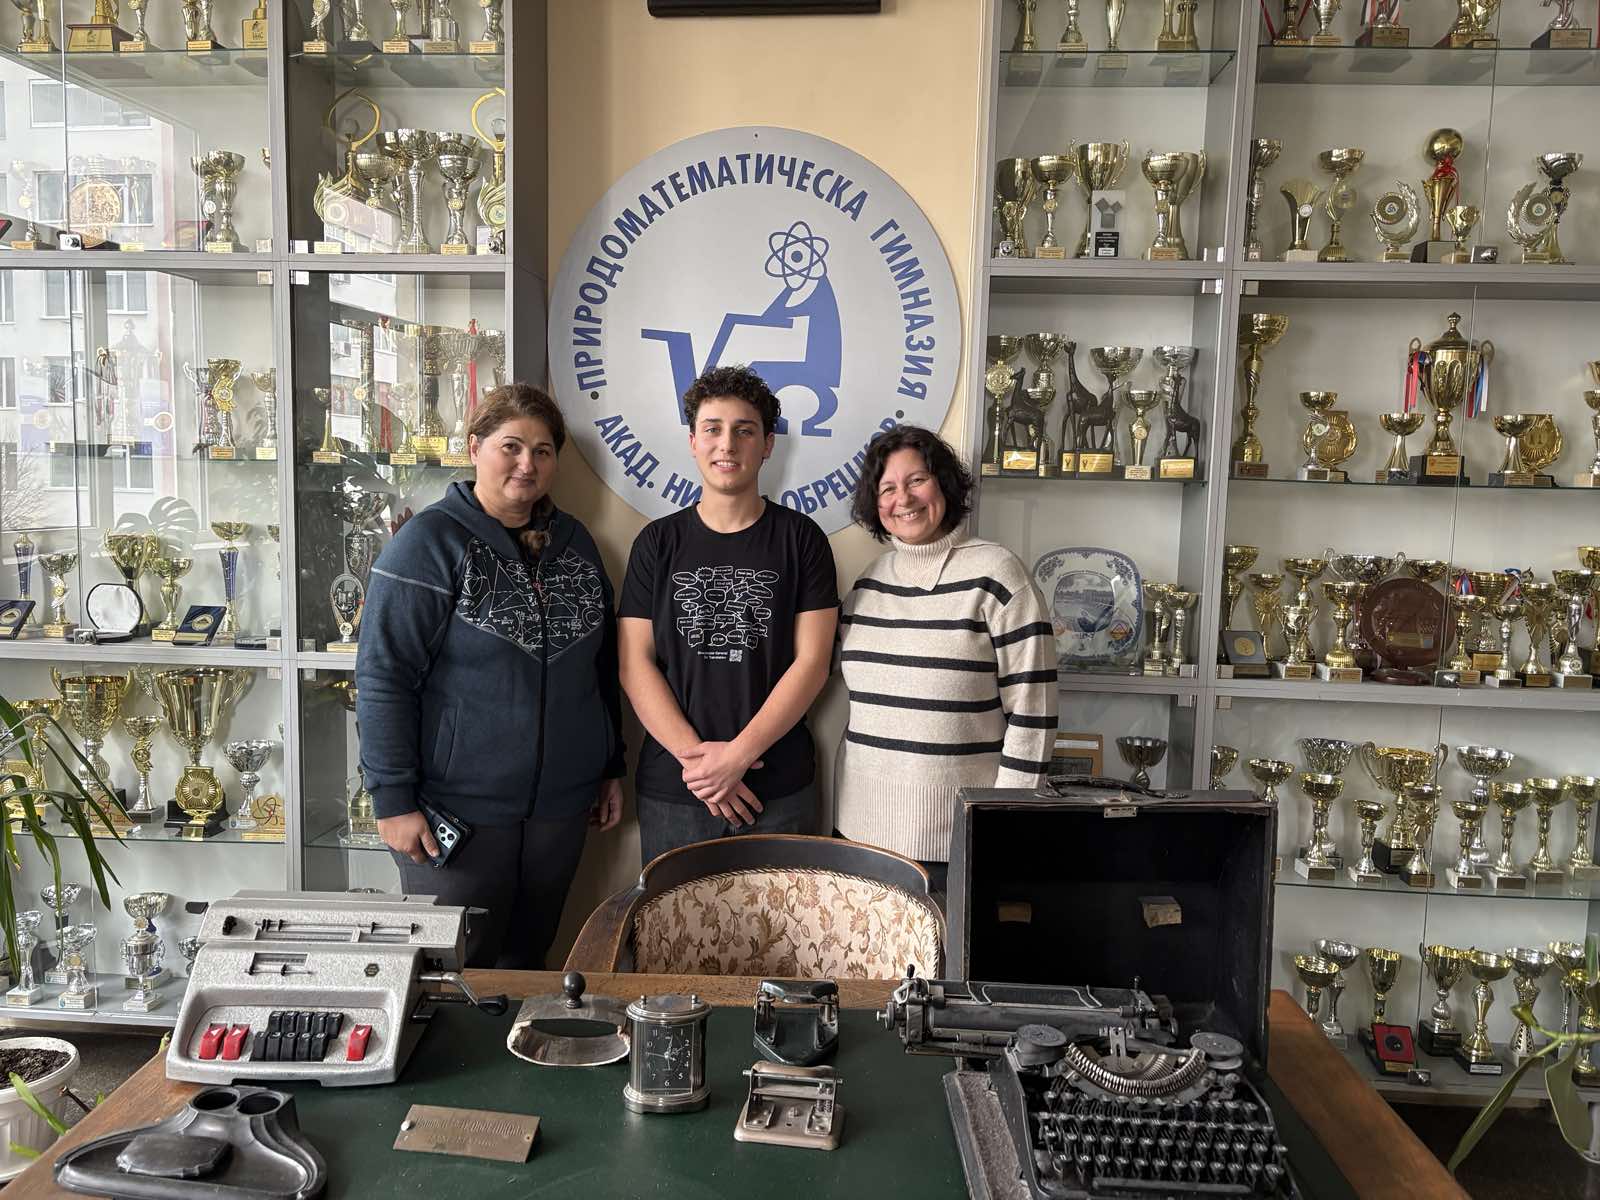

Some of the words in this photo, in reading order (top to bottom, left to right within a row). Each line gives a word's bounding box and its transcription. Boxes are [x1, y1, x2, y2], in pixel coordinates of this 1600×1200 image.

[572, 152, 869, 392] ПРИРОДОМАТЕМАТИЧЕСКА
[870, 217, 936, 401] ГИМНАЗИЯ
[594, 414, 660, 489] АКАД.
